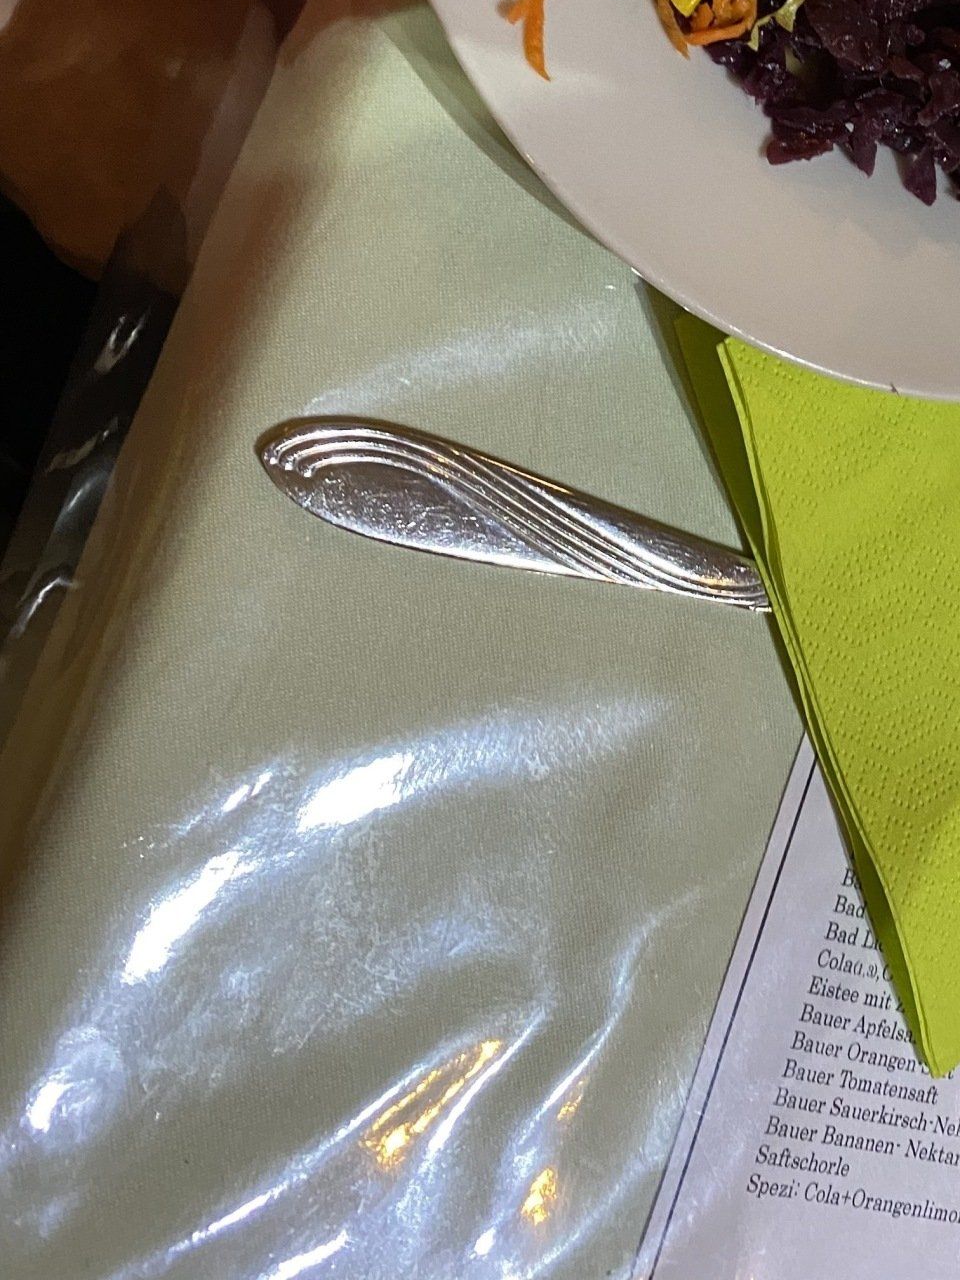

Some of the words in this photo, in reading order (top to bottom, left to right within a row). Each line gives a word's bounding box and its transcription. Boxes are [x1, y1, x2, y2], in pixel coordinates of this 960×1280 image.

[833, 894, 868, 919] Bad
[825, 921, 858, 945] Bad
[808, 975, 859, 1004] Eistee
[864, 988, 892, 1010] mit
[800, 1002, 851, 1032] Bauer
[853, 1014, 916, 1045] Apfelsa
[790, 1030, 843, 1058] Bauer
[782, 1059, 835, 1087] Bauer
[839, 1069, 938, 1105] Tomatensaft
[773, 1087, 827, 1115] Bauer
[764, 1115, 818, 1143] Bauer
[755, 1144, 850, 1178] Saftschorle
[746, 1173, 800, 1199] Spezi:
